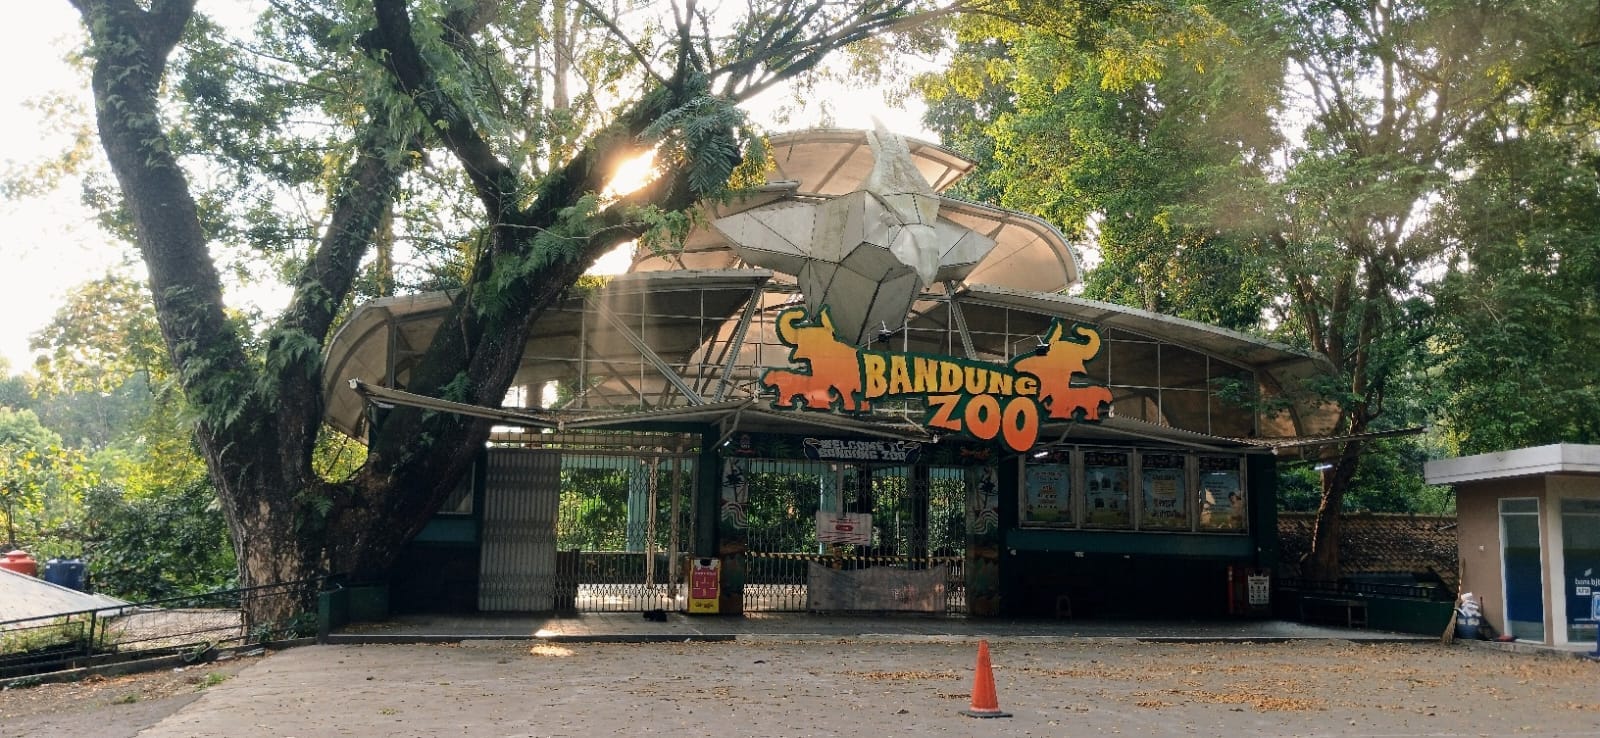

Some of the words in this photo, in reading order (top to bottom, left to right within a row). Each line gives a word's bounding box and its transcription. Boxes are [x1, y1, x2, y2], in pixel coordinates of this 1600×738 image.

[864, 354, 1037, 398] BANDUNG
[928, 394, 1039, 451] ZOO
[819, 440, 884, 451] WELCOME
[882, 450, 906, 461] ZOO
